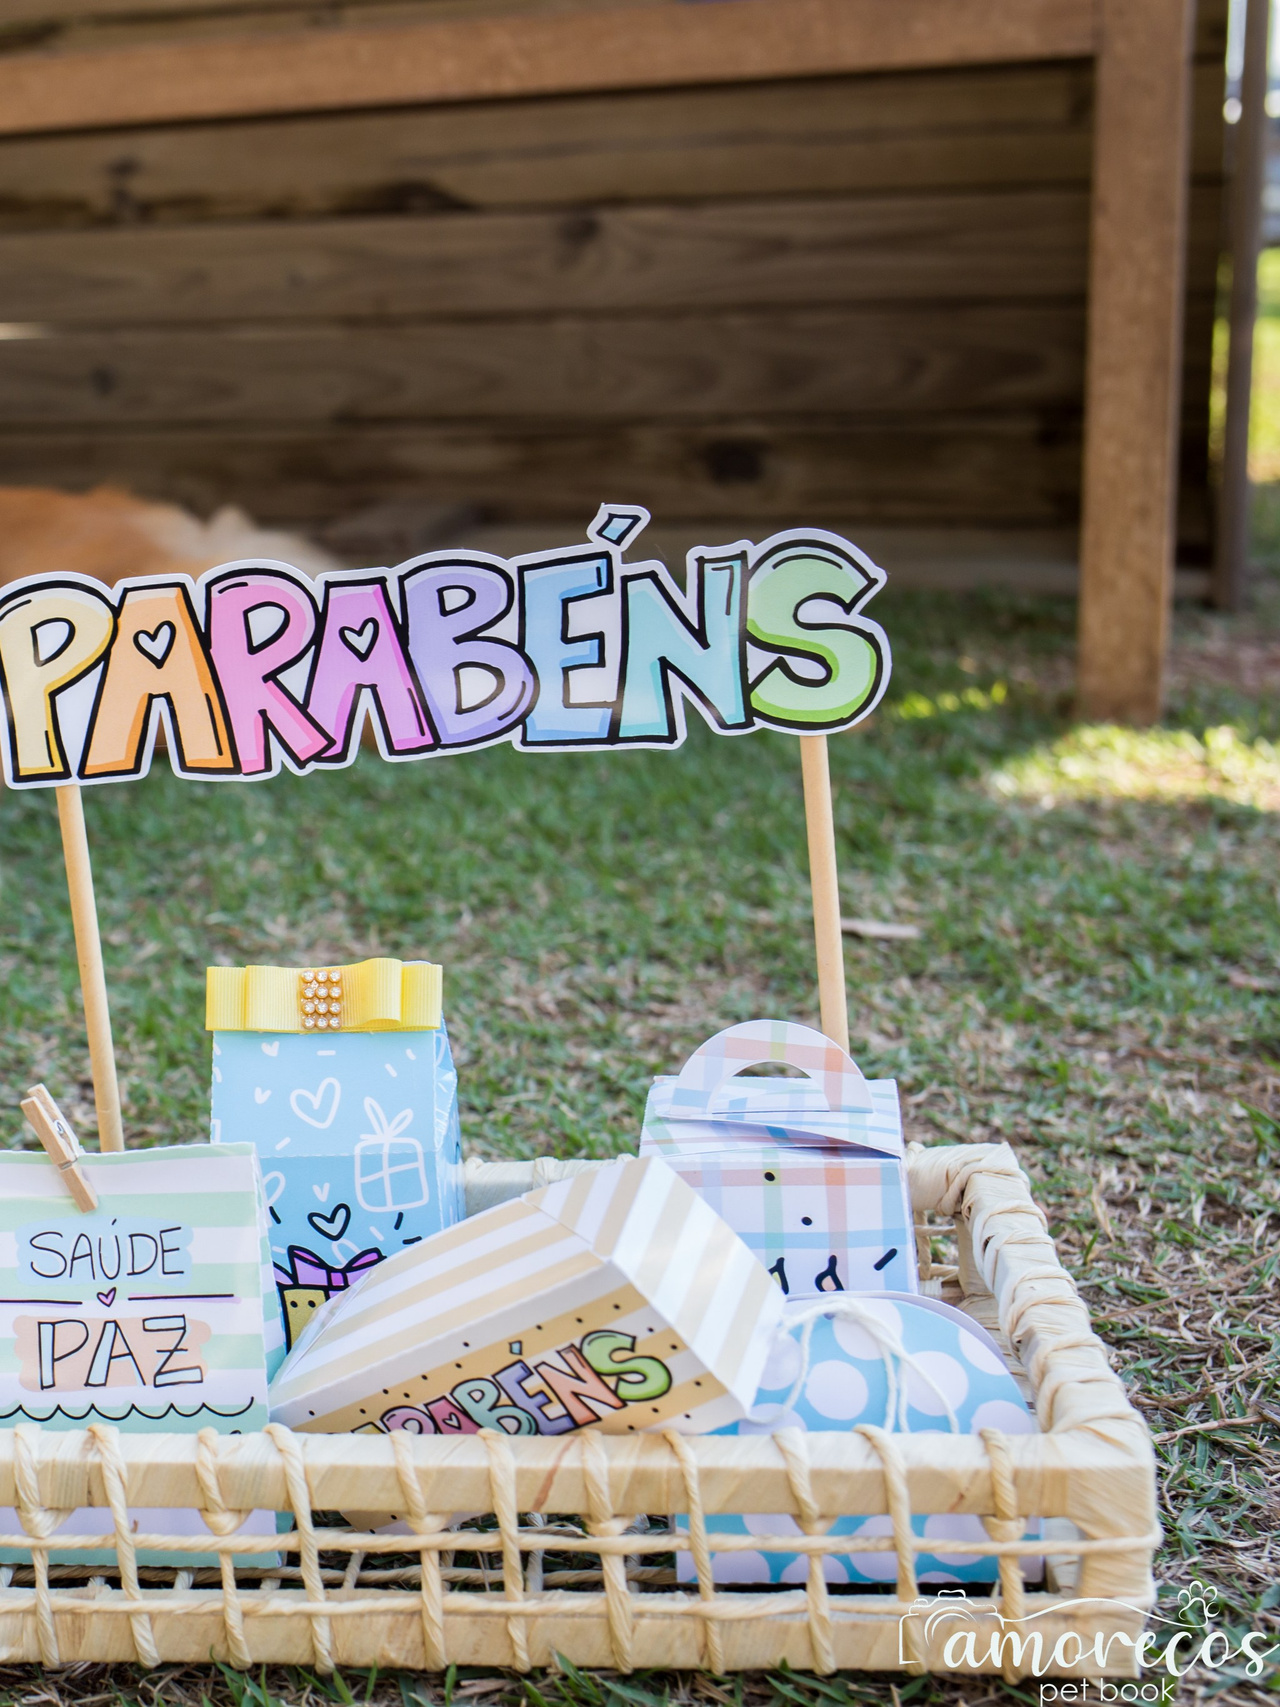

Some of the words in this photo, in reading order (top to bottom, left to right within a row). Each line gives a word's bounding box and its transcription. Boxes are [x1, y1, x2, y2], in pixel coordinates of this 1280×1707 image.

[29, 1219, 185, 1280] SAÚDE
[36, 1314, 205, 1390] PAZ
[328, 1328, 673, 1435] ABÉNS
